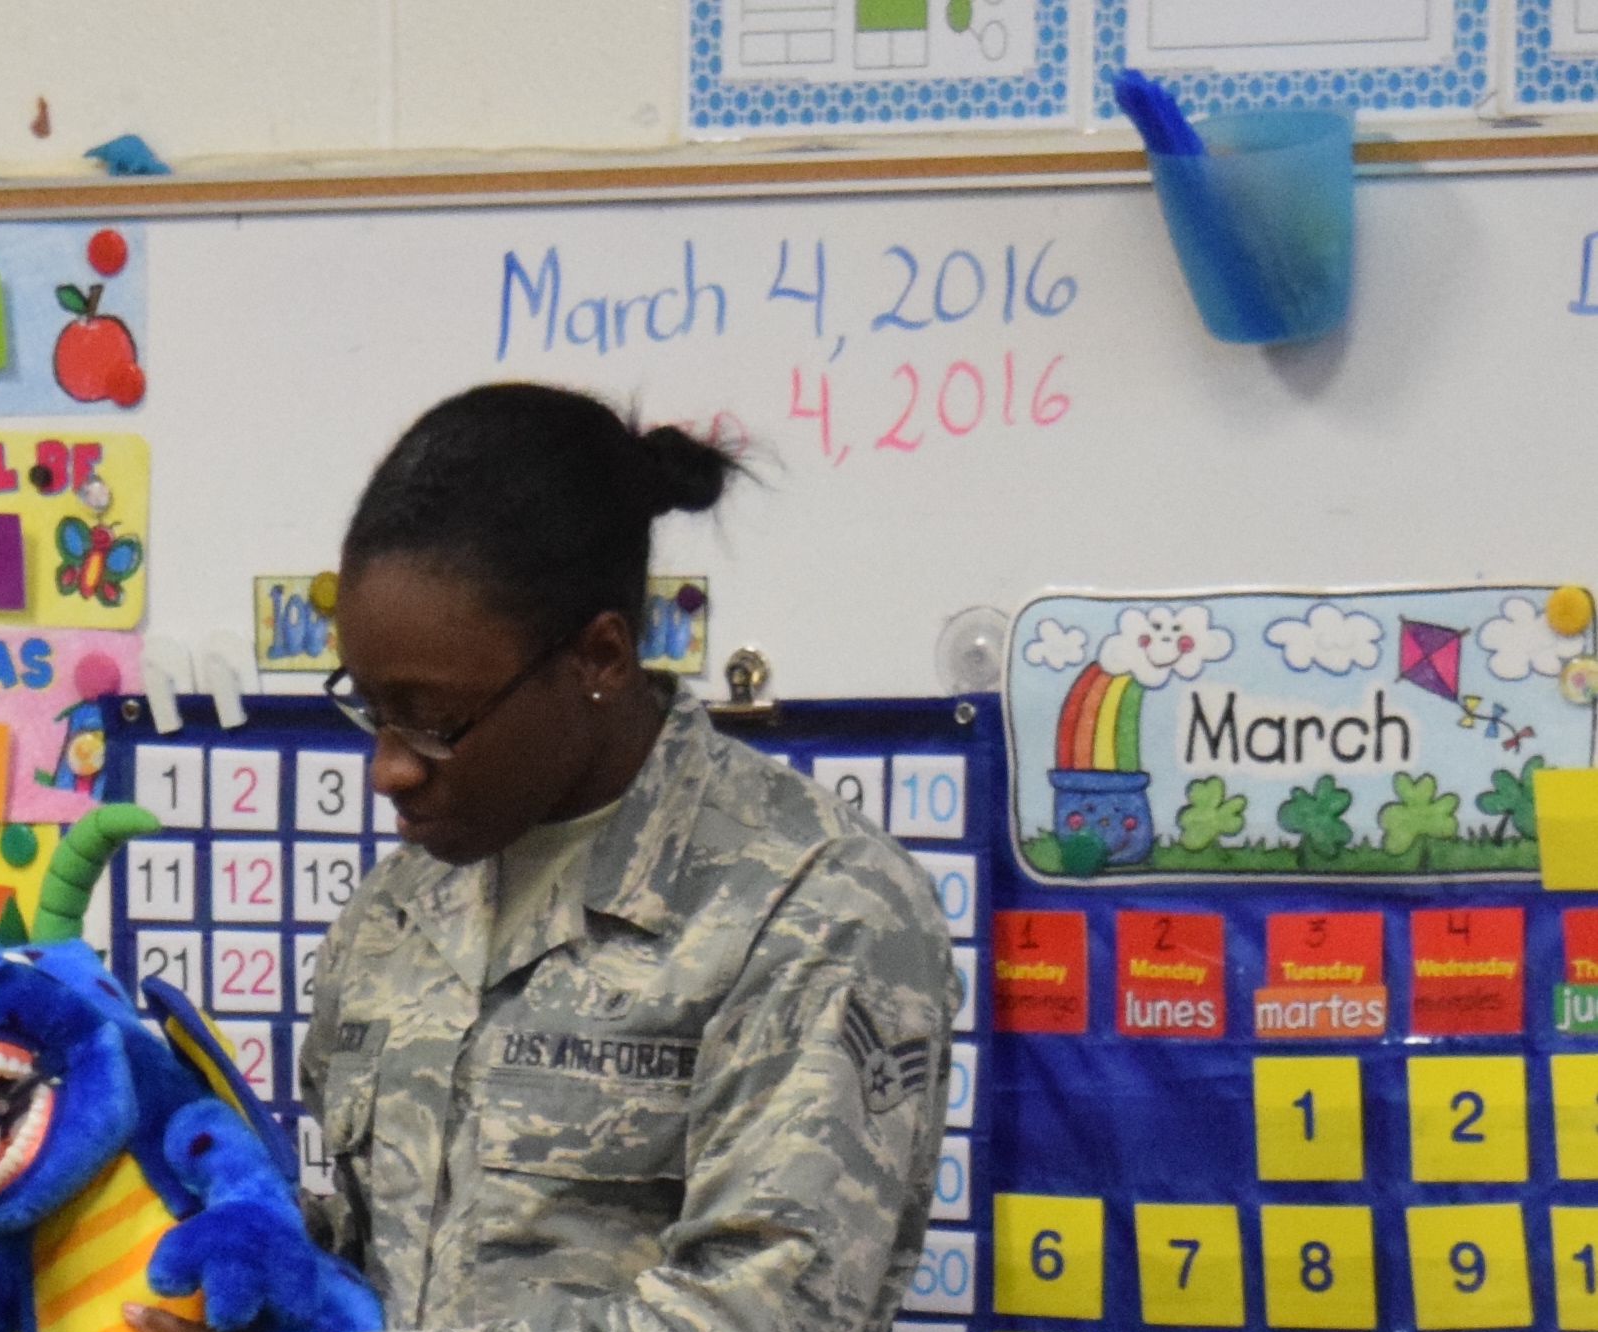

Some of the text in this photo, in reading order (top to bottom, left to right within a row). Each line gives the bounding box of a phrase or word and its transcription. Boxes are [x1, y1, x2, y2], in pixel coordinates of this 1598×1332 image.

[495, 239, 728, 363] March
[871, 239, 1078, 332] 2016
[874, 349, 1071, 453] 2016
[32, 440, 104, 495] BE
[1185, 688, 1412, 764] March
[162, 764, 179, 810] 1
[232, 767, 258, 814] 2
[317, 769, 345, 816] 3
[902, 772, 959, 822] 10
[138, 858, 181, 903] 11
[221, 857, 274, 905] 12
[302, 858, 355, 906] 13
[1017, 917, 1039, 949] 1
[1154, 917, 1174, 950] 2
[1306, 918, 1327, 948] 3
[1447, 913, 1470, 945] 4
[143, 946, 189, 992] 21
[220, 947, 277, 995] 22
[1129, 958, 1208, 986] Monday
[1282, 960, 1365, 983] Tuesday
[1125, 989, 1216, 1029] lunes
[1256, 994, 1385, 1029] martes
[601, 1040, 698, 1079] FORCE
[1293, 1089, 1485, 1144] 1 2
[910, 1248, 970, 1298] 60
[1030, 1229, 1064, 1281] 6
[1168, 1238, 1201, 1290] 7
[1299, 1240, 1334, 1293] 8
[1448, 1241, 1486, 1294] 9
